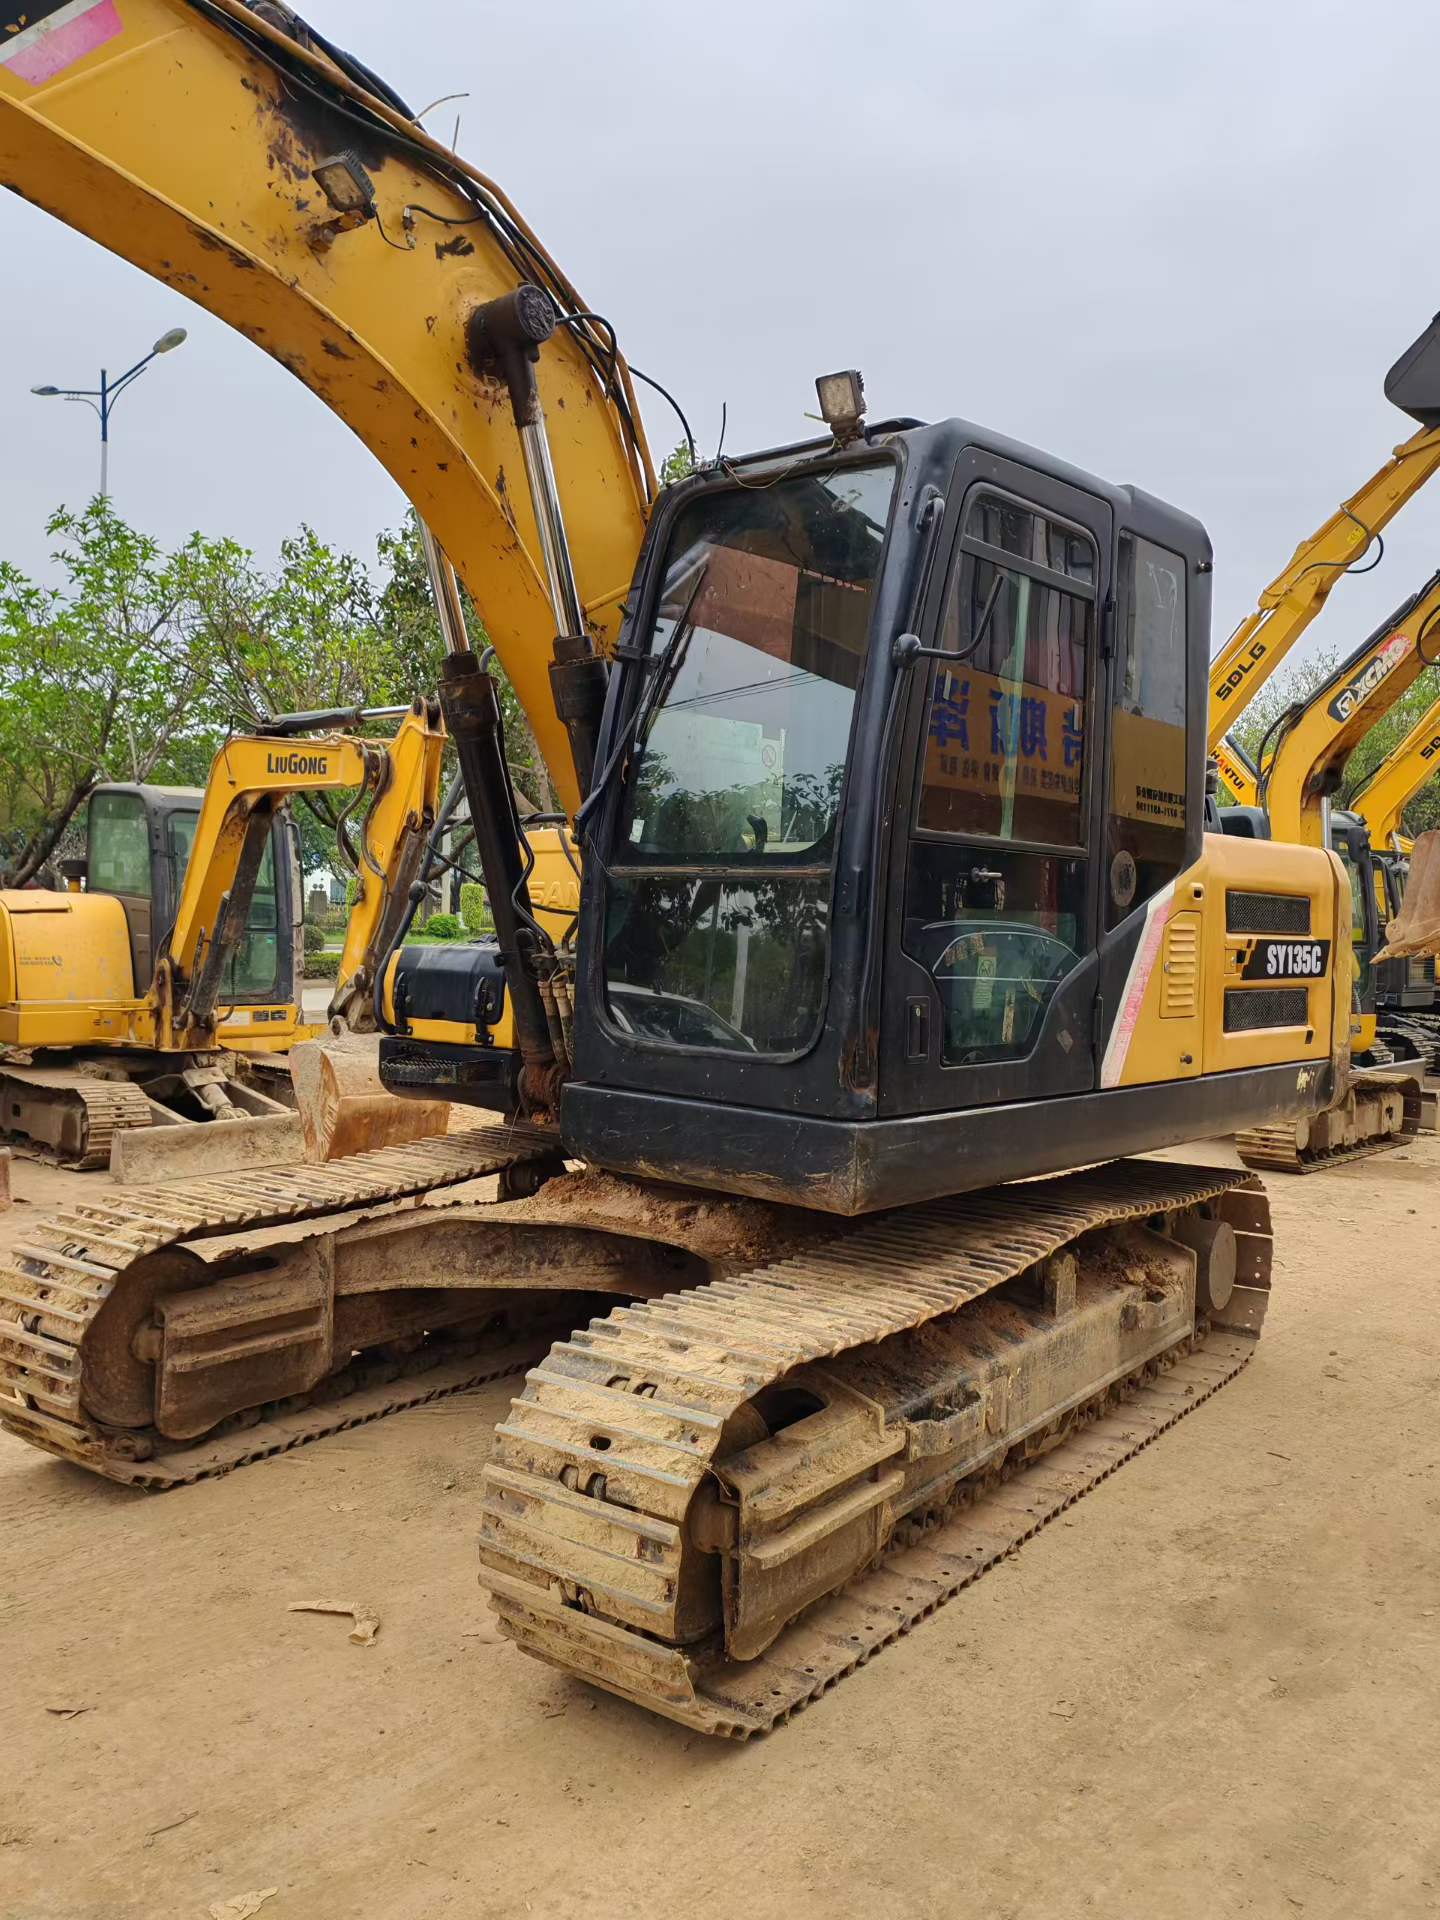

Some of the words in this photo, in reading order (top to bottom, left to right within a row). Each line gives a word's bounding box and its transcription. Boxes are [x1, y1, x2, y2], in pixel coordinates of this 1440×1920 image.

[1215, 641, 1266, 701] SDLG
[1352, 638, 1408, 707] XCMG
[267, 752, 327, 775] LIUGONG
[1266, 944, 1322, 975] SY135C
